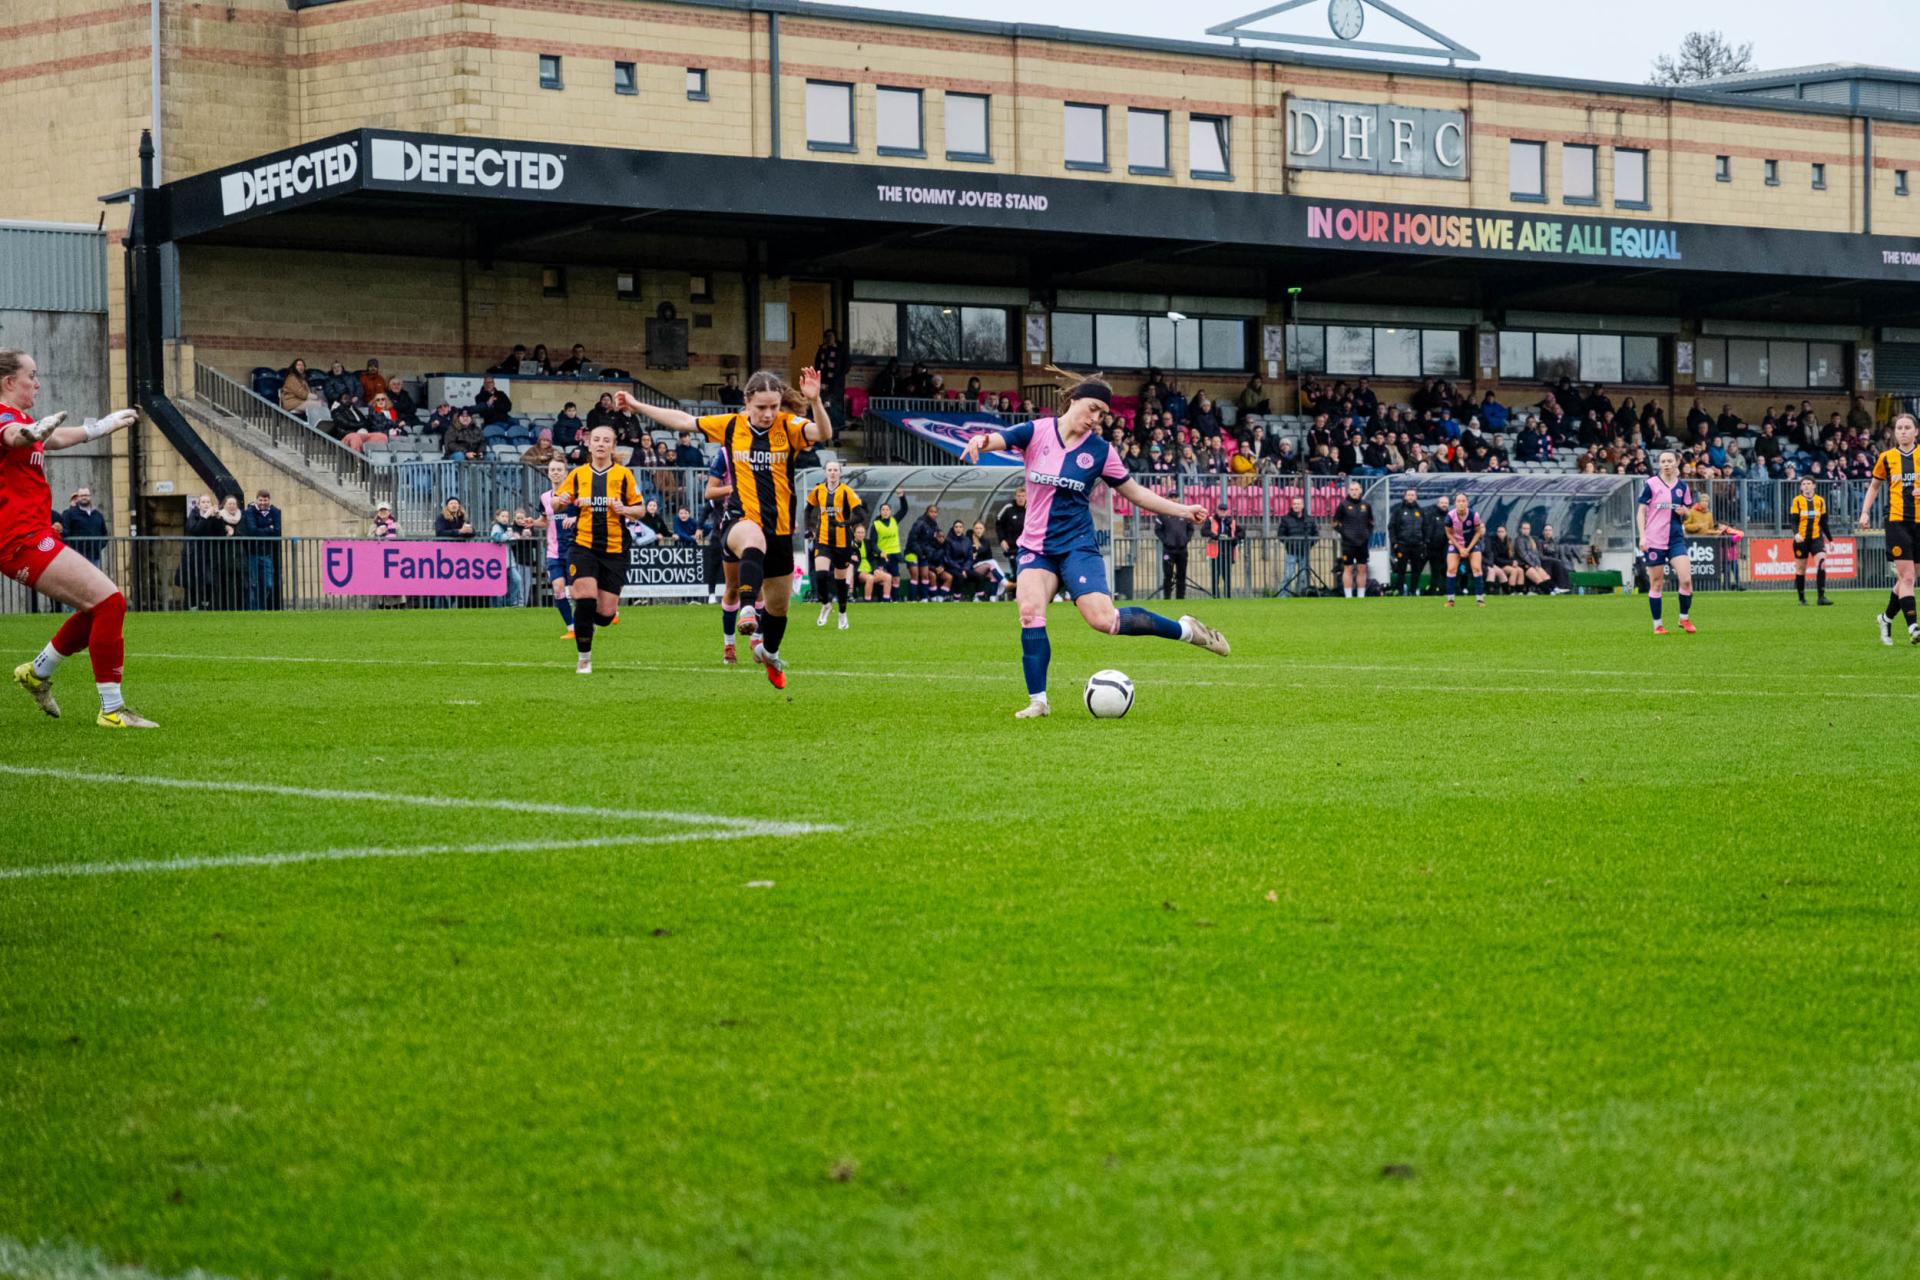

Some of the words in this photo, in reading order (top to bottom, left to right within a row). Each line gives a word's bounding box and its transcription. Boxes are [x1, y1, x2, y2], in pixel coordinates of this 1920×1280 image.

[371, 138, 565, 190] DEFECTED
[220, 143, 358, 216] DEFECTED
[877, 185, 902, 202] THE
[904, 187, 957, 206] TOMMY
[957, 190, 1003, 208] JOVER
[1005, 193, 1049, 211] STAND
[1307, 206, 1333, 239] IN
[1336, 208, 1390, 243] OUR
[1393, 213, 1473, 249] HOUSE
[1475, 217, 1515, 251] WE
[1517, 221, 1563, 254] ARE
[1566, 224, 1607, 256] ALL
[1610, 227, 1682, 261] EQUAL
[1882, 251, 1900, 265] THE
[1900, 251, 1920, 266] TOM
[1030, 471, 1086, 492] DEFECTED
[383, 548, 502, 580] Fanbase
[629, 548, 694, 565] ESPOKE
